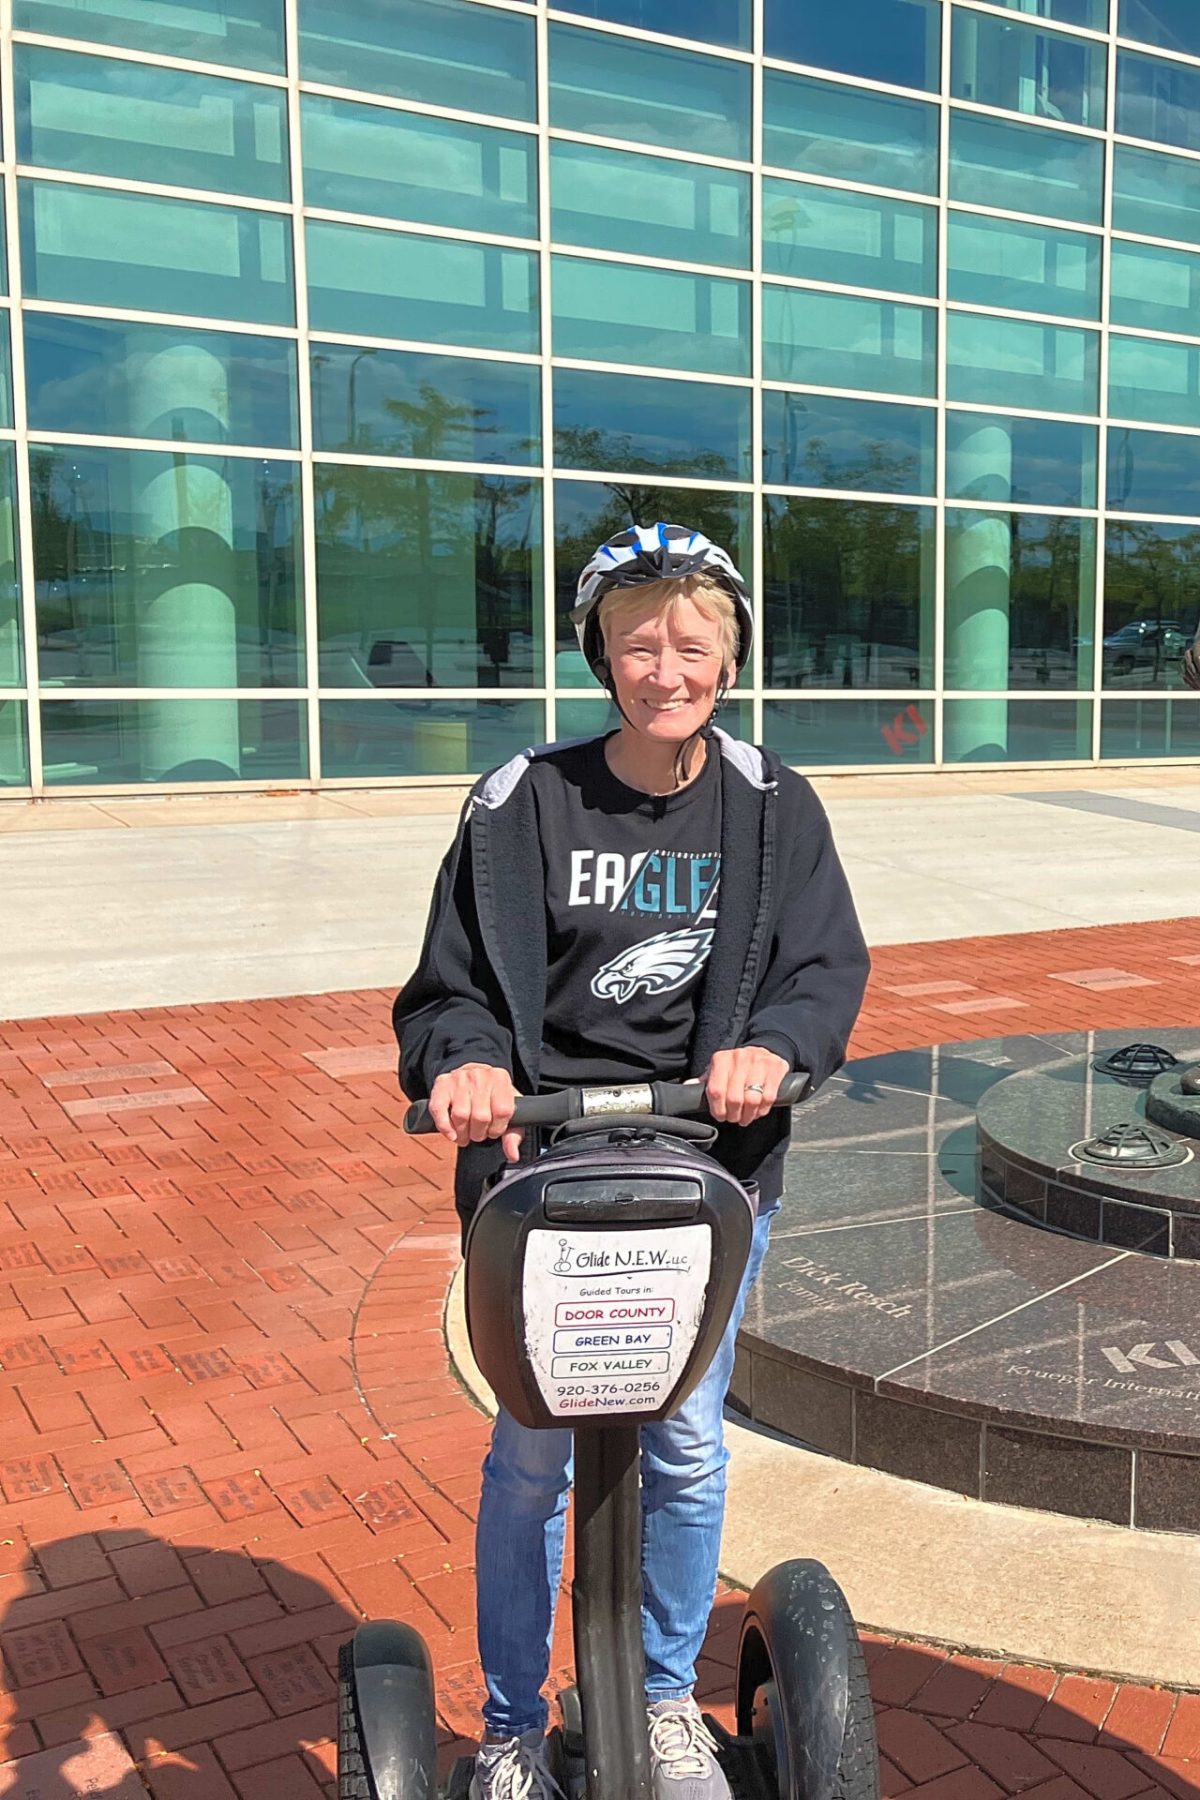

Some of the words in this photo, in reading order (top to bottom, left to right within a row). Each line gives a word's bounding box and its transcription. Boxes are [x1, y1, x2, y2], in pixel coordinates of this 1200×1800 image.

[568, 850, 721, 924] EAGLE
[576, 1250, 610, 1267] Glide
[579, 1288, 611, 1297] Guided
[615, 1287, 640, 1295] Tours
[781, 1256, 842, 1284] Dick
[835, 1281, 912, 1318] Resch
[565, 1309, 603, 1321] DOOR
[609, 1307, 665, 1319] COUNTY
[575, 1336, 620, 1346] GREEN
[625, 1334, 651, 1344] BAY
[570, 1362, 598, 1372] FOX
[604, 1360, 652, 1370] VALLEY
[1006, 1365, 1098, 1386] Krueger
[557, 1382, 660, 1396] 920-376-0256
[559, 1397, 656, 1409] GlideNew.com
